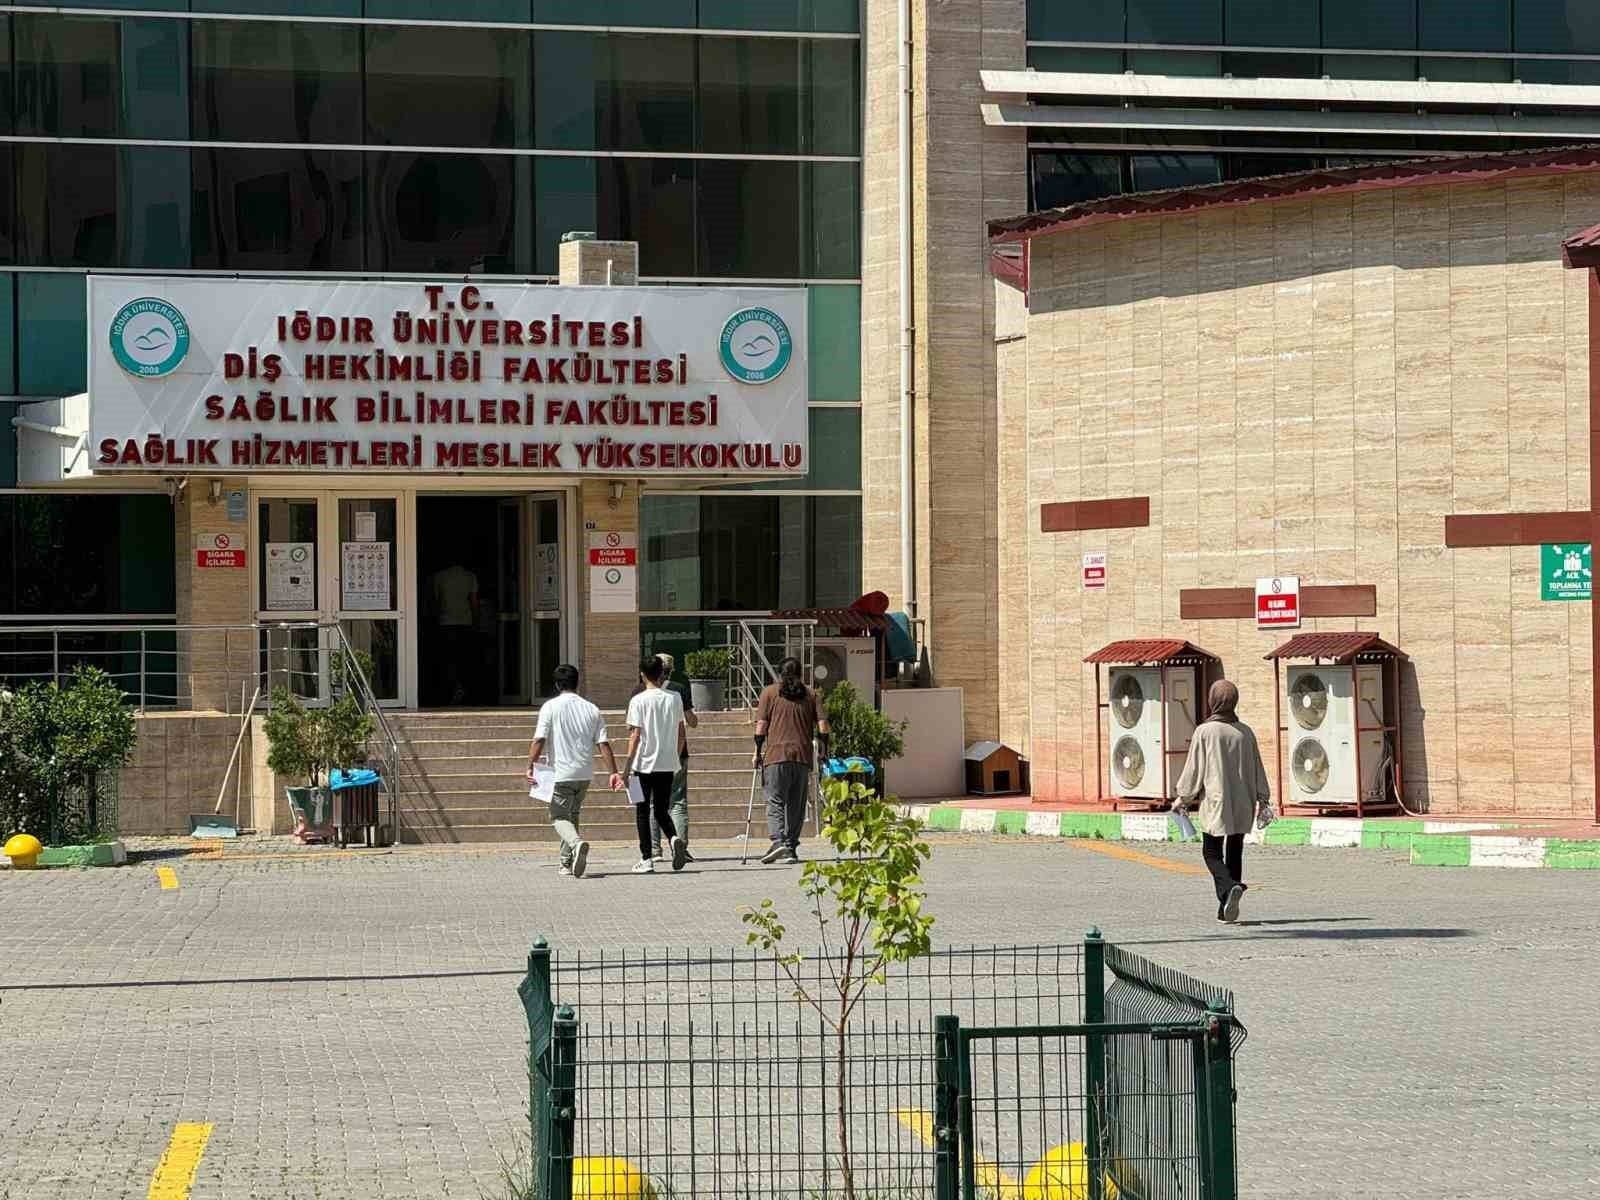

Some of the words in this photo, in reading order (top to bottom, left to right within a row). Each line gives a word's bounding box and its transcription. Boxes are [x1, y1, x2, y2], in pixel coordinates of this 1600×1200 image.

[425, 286, 493, 311] T.C.
[277, 310, 375, 344] IĞDIR
[393, 311, 642, 349] ÜNİVERSİTESİ
[223, 346, 282, 383] DİŞ
[304, 348, 481, 383] HEKİMLİĞİ
[503, 351, 688, 386] FAKÜLTESİ
[206, 391, 338, 424] SAĞLIK
[356, 390, 535, 426] BİLİMLERİ
[545, 393, 718, 427] FAKÜLTESİ
[98, 433, 220, 466] SAĞLIK
[230, 434, 423, 467] HİZMETLERİ
[436, 442, 562, 468] MESLEK
[575, 438, 803, 469] YÜKSEKOKULU
